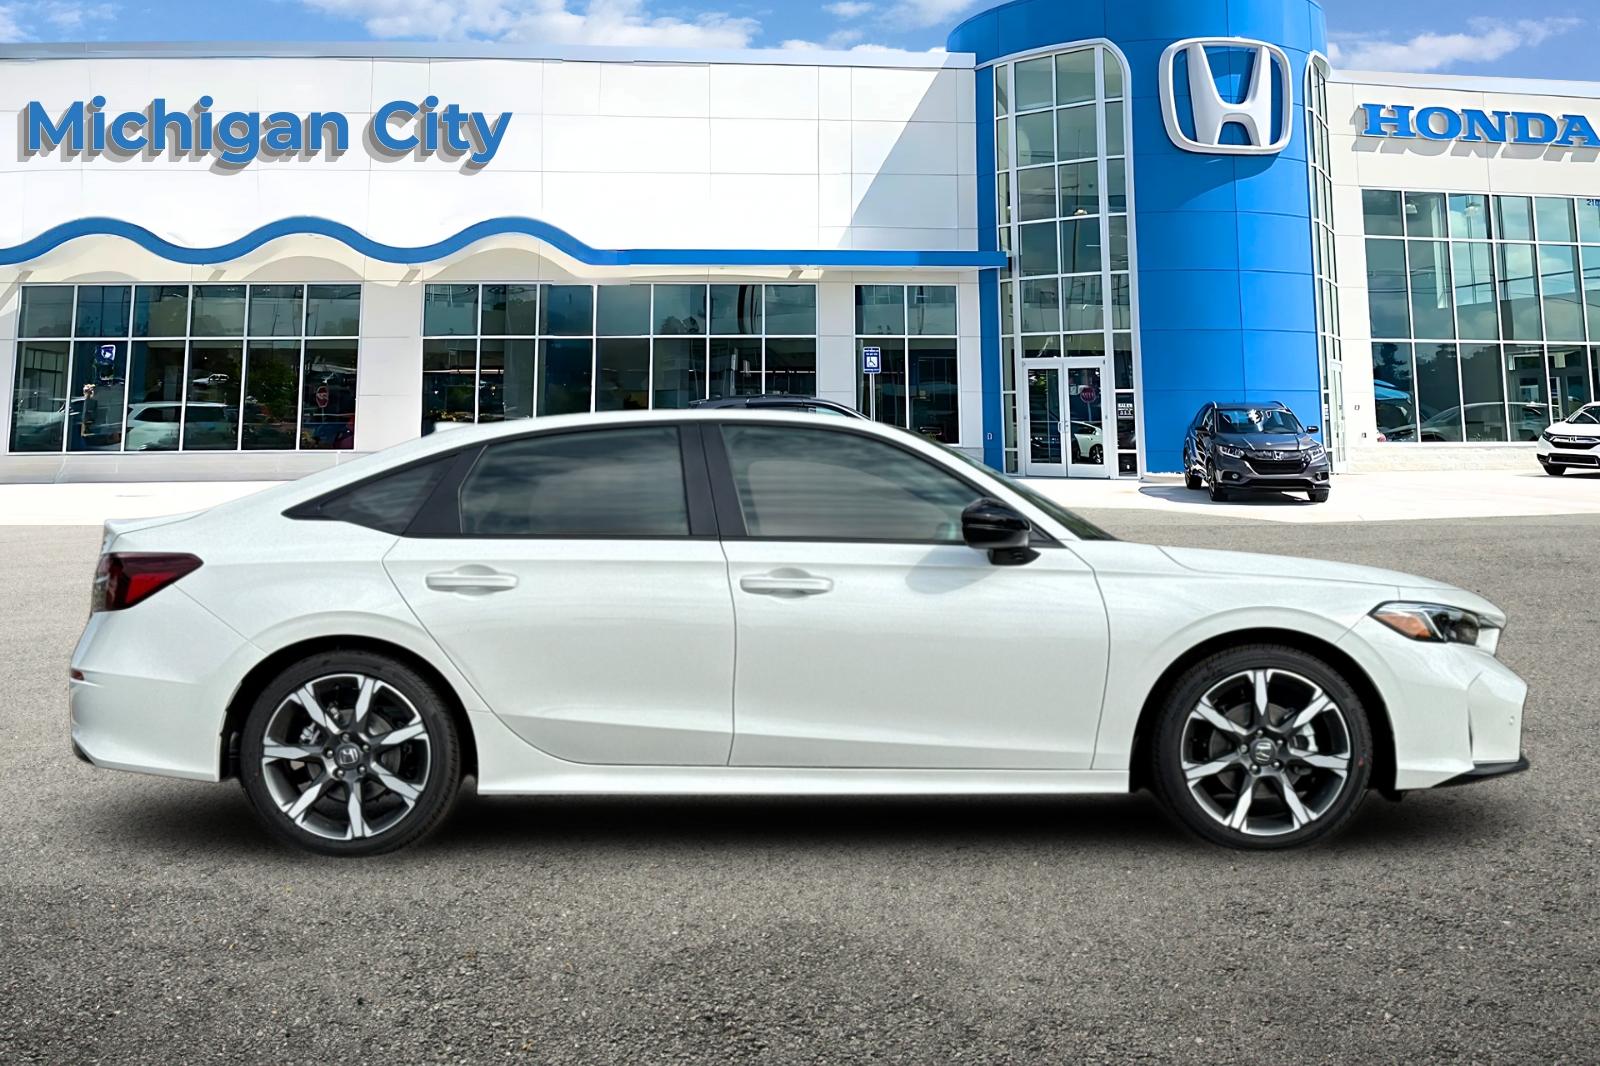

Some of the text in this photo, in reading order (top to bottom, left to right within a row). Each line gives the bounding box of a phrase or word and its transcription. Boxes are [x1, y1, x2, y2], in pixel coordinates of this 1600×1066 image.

[28, 95, 513, 164] Michigan City
[1361, 102, 1600, 148] HONDA
